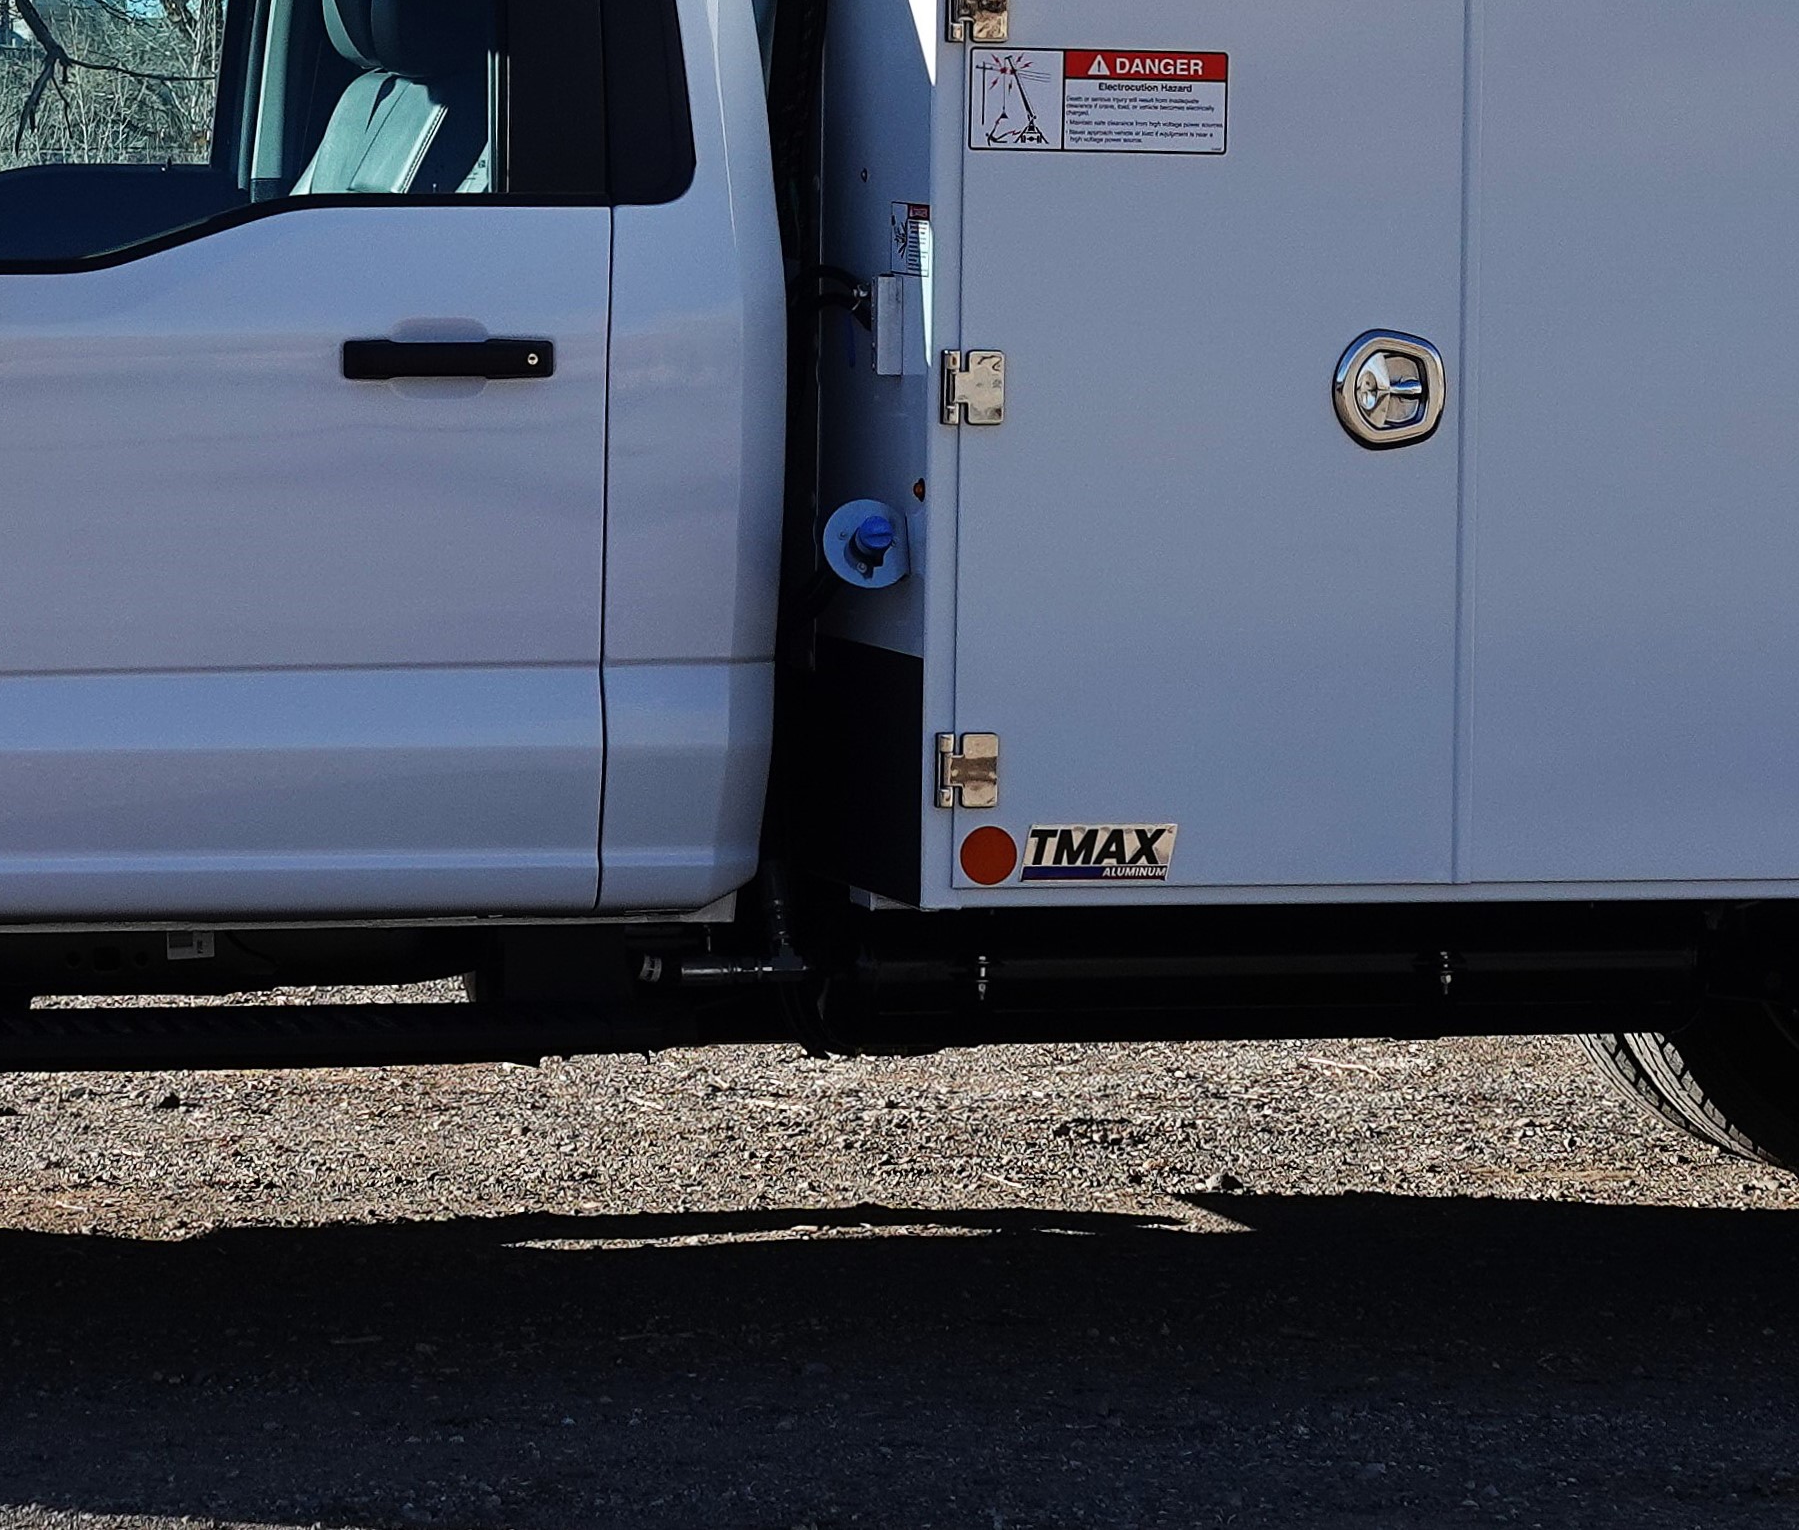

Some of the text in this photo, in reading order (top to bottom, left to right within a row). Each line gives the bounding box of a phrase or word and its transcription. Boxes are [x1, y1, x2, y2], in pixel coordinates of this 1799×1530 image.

[1115, 57, 1203, 75] DANGER
[1098, 82, 1192, 93] Electrocution Hazard
[1030, 828, 1166, 866] TMAX
[1102, 866, 1167, 878] ALUMINUM
